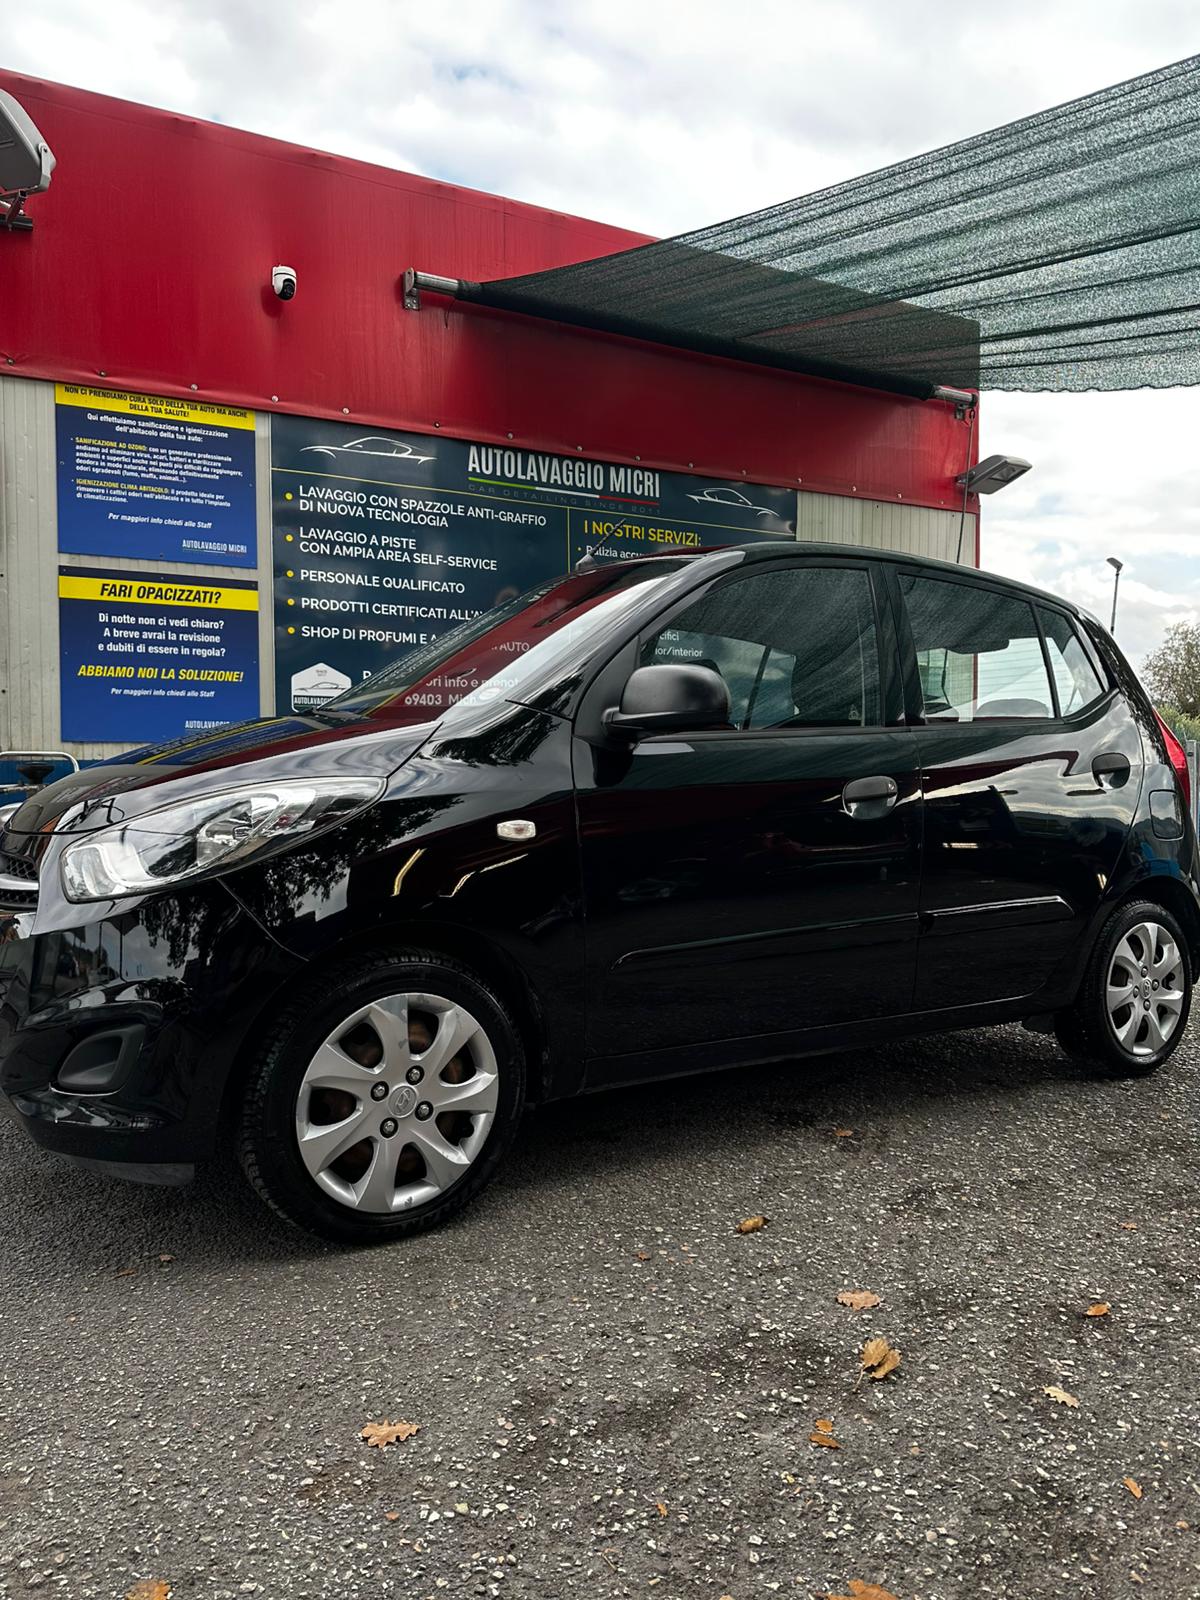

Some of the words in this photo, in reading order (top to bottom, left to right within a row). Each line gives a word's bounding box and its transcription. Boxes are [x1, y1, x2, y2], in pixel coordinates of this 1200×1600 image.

[64, 386, 79, 395] NON
[89, 390, 127, 400] PRENDIAMO
[129, 395, 146, 404] CURA
[148, 397, 164, 406] SOLO
[166, 400, 185, 410] DELLA
[200, 405, 215, 413] AUTO
[228, 410, 247, 418] ANCHE
[129, 404, 149, 412] DELLA
[150, 406, 163, 414] TUA
[164, 408, 189, 417] SALUTE!
[100, 415, 136, 426] effettuiamo
[138, 420, 179, 431] sanificazione
[186, 426, 228, 438] igienizzazione
[116, 425, 158, 437] dell'abitacolo
[159, 431, 174, 439] della
[75, 437, 117, 447] SANIFICAZIONE
[168, 449, 196, 458] generatore
[198, 453, 232, 462] professionale
[124, 463, 148, 472] naturale,
[149, 467, 178, 475] eliminando
[179, 470, 219, 479] definitivamente
[193, 459, 221, 467] sterilizzare
[468, 445, 604, 490] AUTOLAVAGGIO
[610, 466, 660, 498] MICRI
[76, 478, 119, 488] IGIENIZZAZIONE
[139, 485, 169, 494] ABITACOLO:
[83, 493, 128, 502] climatizzazione.
[143, 493, 179, 502] nell'abitacolo
[299, 485, 366, 504] LAVAGGIO
[370, 495, 398, 508] CON
[400, 499, 465, 516] SPAZZOLE
[467, 506, 546, 526] ANTI-GRAFFIO
[468, 484, 496, 495] CAR
[503, 489, 577, 505] DETAILING
[585, 500, 624, 510] SINCE
[120, 514, 149, 523] maggiori
[300, 500, 313, 512] DI
[317, 502, 364, 518] NUOVA
[366, 507, 448, 527] TECNOLOGIA
[300, 526, 367, 544] LAVAGGIO
[370, 535, 379, 546] A
[382, 536, 416, 550] PISTE
[584, 520, 588, 533] I
[592, 520, 645, 540] NOSTRI
[648, 528, 701, 547] SERVIZI:
[182, 539, 227, 552] AUTOLAVAGGIO
[228, 544, 247, 553] MICRI
[300, 541, 330, 554] CON
[333, 545, 375, 559] AMPIA
[377, 550, 410, 562] AREA
[413, 552, 497, 570] SELF-SERVICE
[300, 569, 380, 587] PERSONALE
[383, 577, 465, 593] QUALIFICATO
[100, 583, 132, 598] FARI
[137, 586, 222, 604] OPACIZZATI?
[301, 597, 369, 613] PRODOTTI
[372, 603, 446, 619] CERTIFICATI
[98, 612, 108, 623] Di
[111, 614, 136, 624] notte
[138, 617, 155, 625] non
[158, 616, 166, 625] ci
[169, 617, 188, 627] vedi
[190, 619, 224, 629] chiaro?
[104, 628, 110, 637] A
[113, 628, 140, 638] breve
[142, 631, 165, 640] avrai
[168, 630, 176, 640] la
[179, 633, 220, 643] revisione
[302, 625, 340, 638] SHOP
[343, 628, 356, 639] DI
[359, 630, 416, 643] PROFUMI
[420, 634, 427, 644] E
[106, 642, 134, 652] dubiti
[137, 644, 145, 653] di
[148, 646, 178, 655] essere
[181, 646, 189, 655] in
[192, 647, 225, 658] regola?
[78, 664, 134, 678] ABBIAMO
[138, 667, 158, 679] NOI
[161, 668, 175, 679] LA
[178, 669, 243, 682] SOLUZIONE!
[445, 676, 468, 687] info
[123, 688, 152, 696] maggiori
[405, 693, 442, 705] 69403
